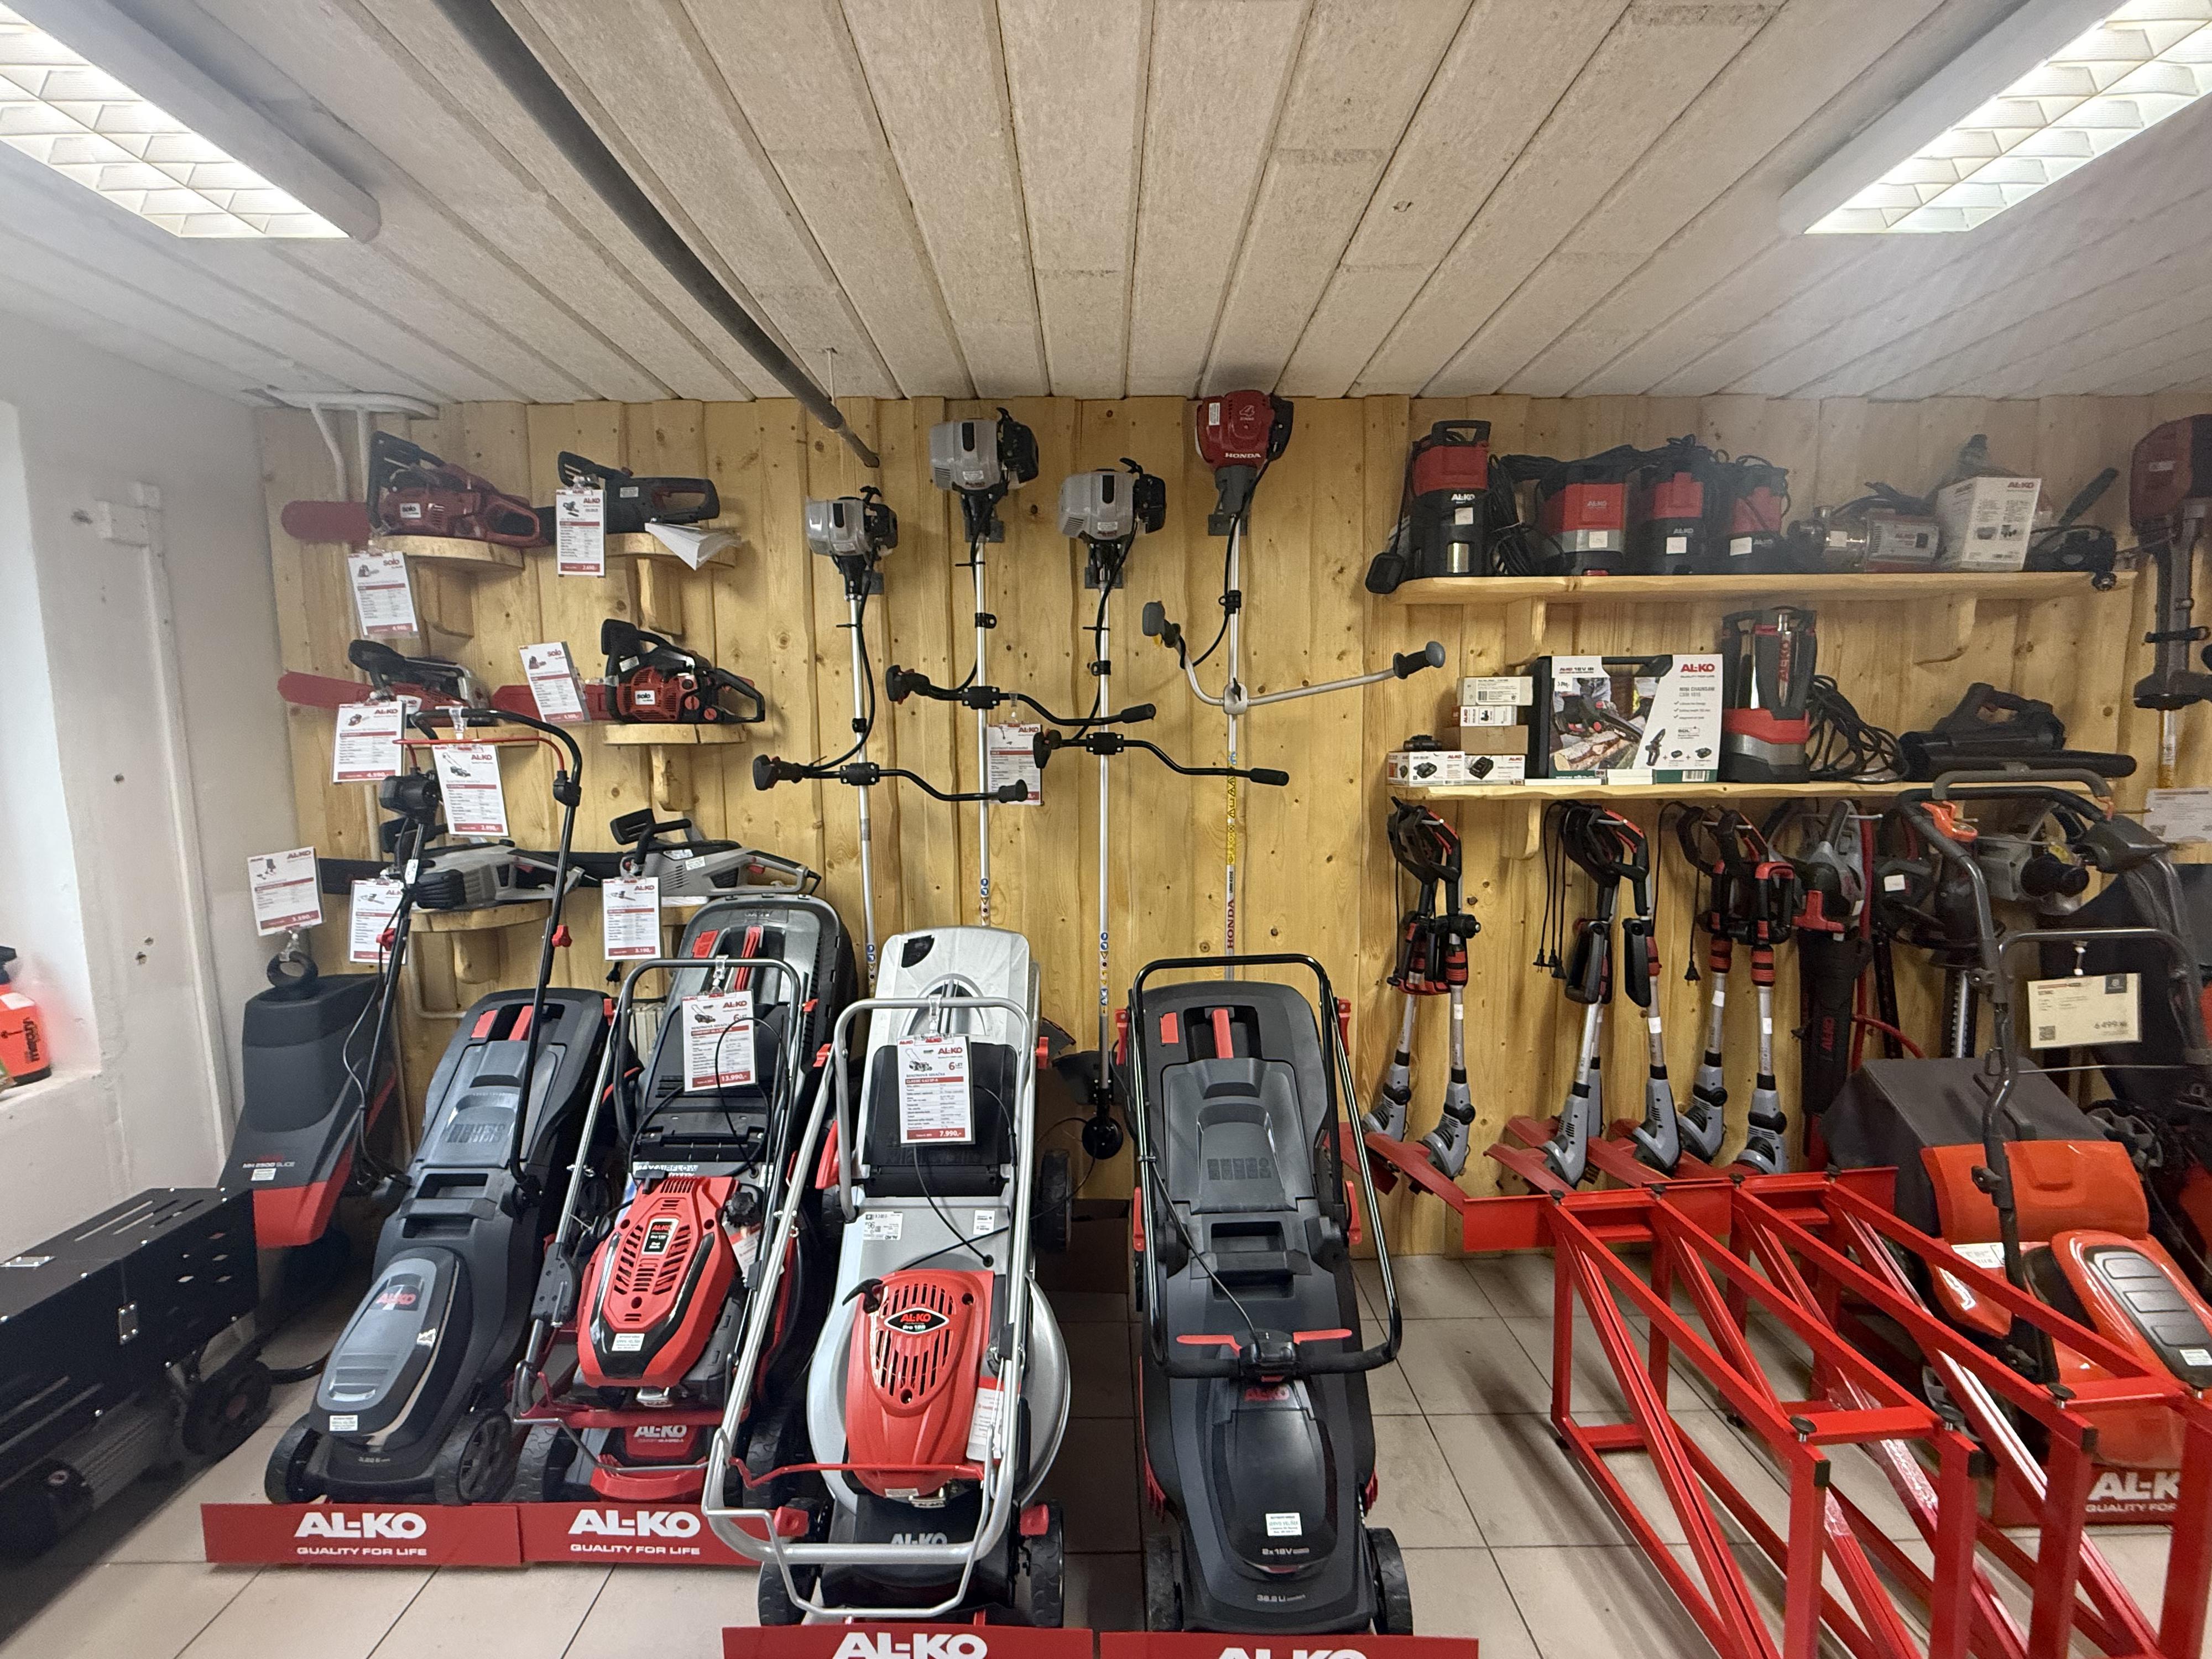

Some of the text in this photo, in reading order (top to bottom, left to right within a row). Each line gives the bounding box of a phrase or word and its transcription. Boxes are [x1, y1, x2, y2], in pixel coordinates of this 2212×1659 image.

[1778, 640, 1792, 683] AL-KO
[1681, 664, 1715, 672] AL-KO
[287, 850, 311, 859] AL-KO
[949, 1062, 955, 1070] 6
[721, 1073, 747, 1082] 13.990,-
[376, 1293, 416, 1305] AL-KO
[900, 1313, 931, 1322] AL-KO
[634, 1425, 687, 1437] AL-KO
[2087, 1471, 2180, 1500] AL-K
[2085, 1503, 2146, 1512] QUALITY
[294, 1512, 427, 1539] AL-KO
[568, 1509, 701, 1538] AL-KO
[891, 1532, 948, 1545] AL-KO
[296, 1547, 427, 1556] QUALITY FOR LIFE
[570, 1543, 700, 1556] QUALITY FOR LIFE
[832, 1634, 988, 1659] AL-KO
